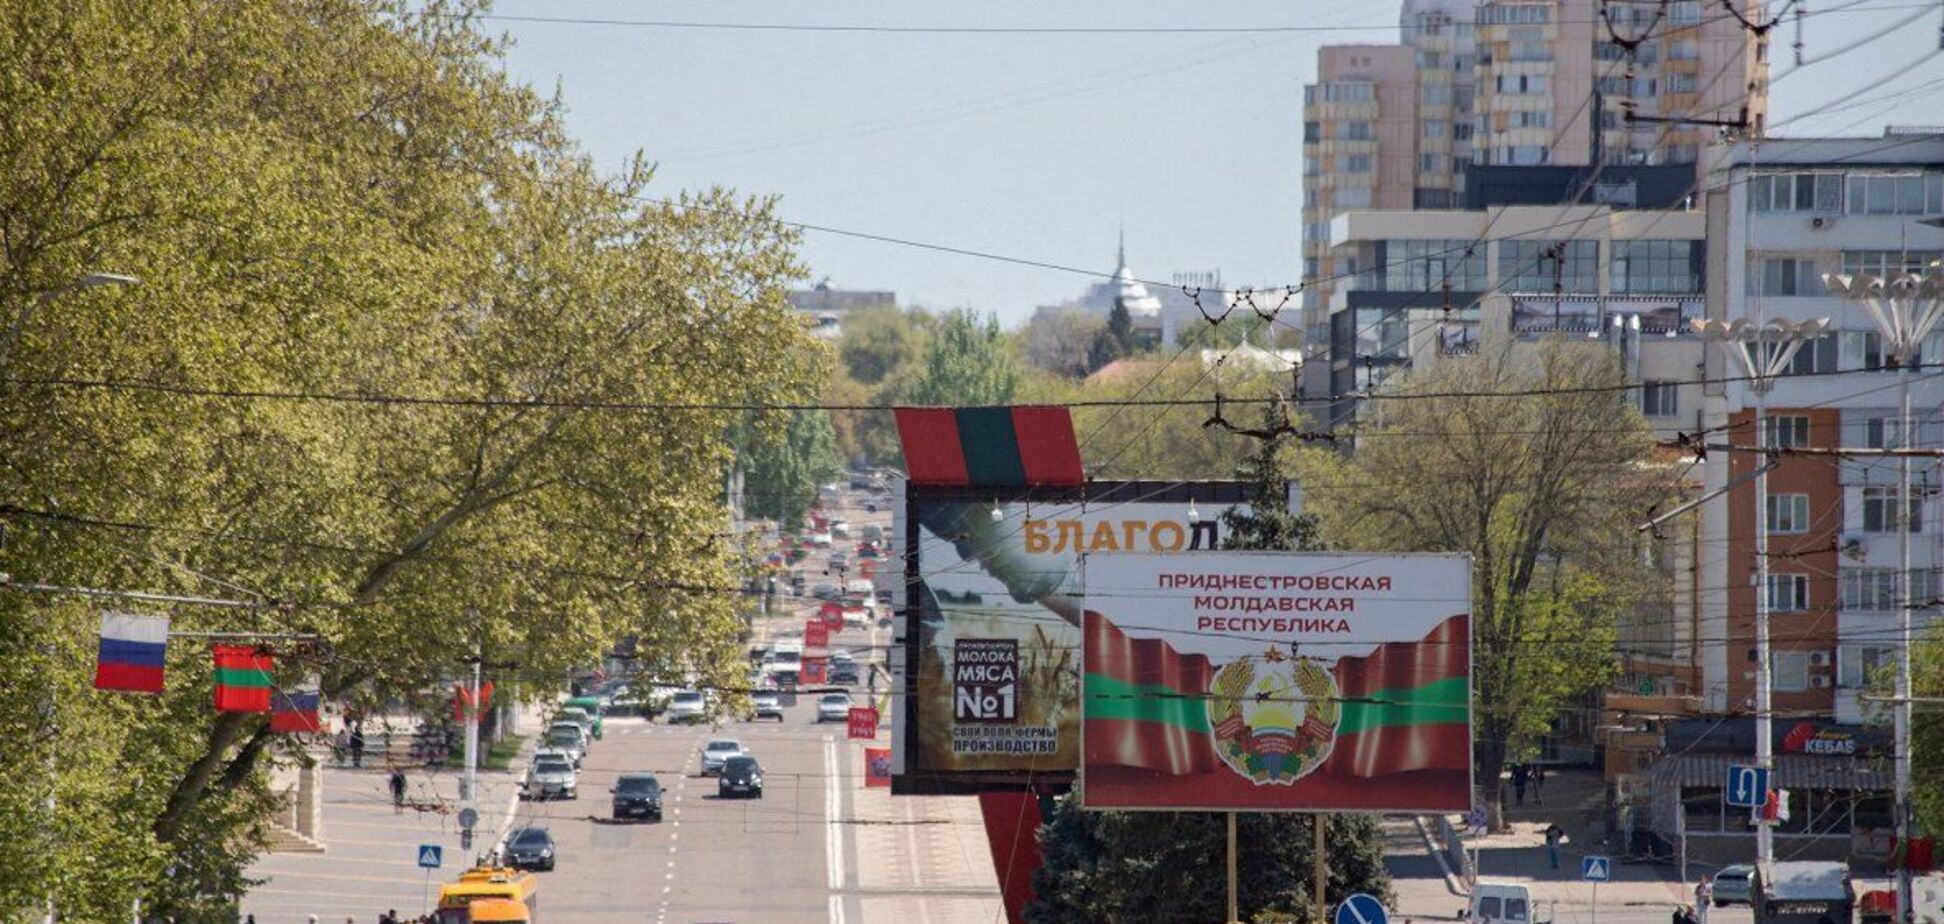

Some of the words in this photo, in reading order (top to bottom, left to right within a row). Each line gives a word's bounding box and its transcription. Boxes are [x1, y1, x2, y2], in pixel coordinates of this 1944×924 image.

[1158, 574, 1391, 591] ПРИДНЕСТРОВСКАЯ
[1194, 596, 1354, 613] МОЛДАВСКАЯ
[1197, 617, 1351, 633] РЕСПУБЛИКА
[957, 651, 1015, 662] МОЛОКА
[957, 665, 1015, 681] МЯСА
[956, 684, 1015, 719] №1
[1015, 727, 1057, 738] ФЕРМЫ
[953, 740, 1056, 753] ПРОИЗВОДСТВО
[1805, 739, 1855, 753] КЕБАБ
